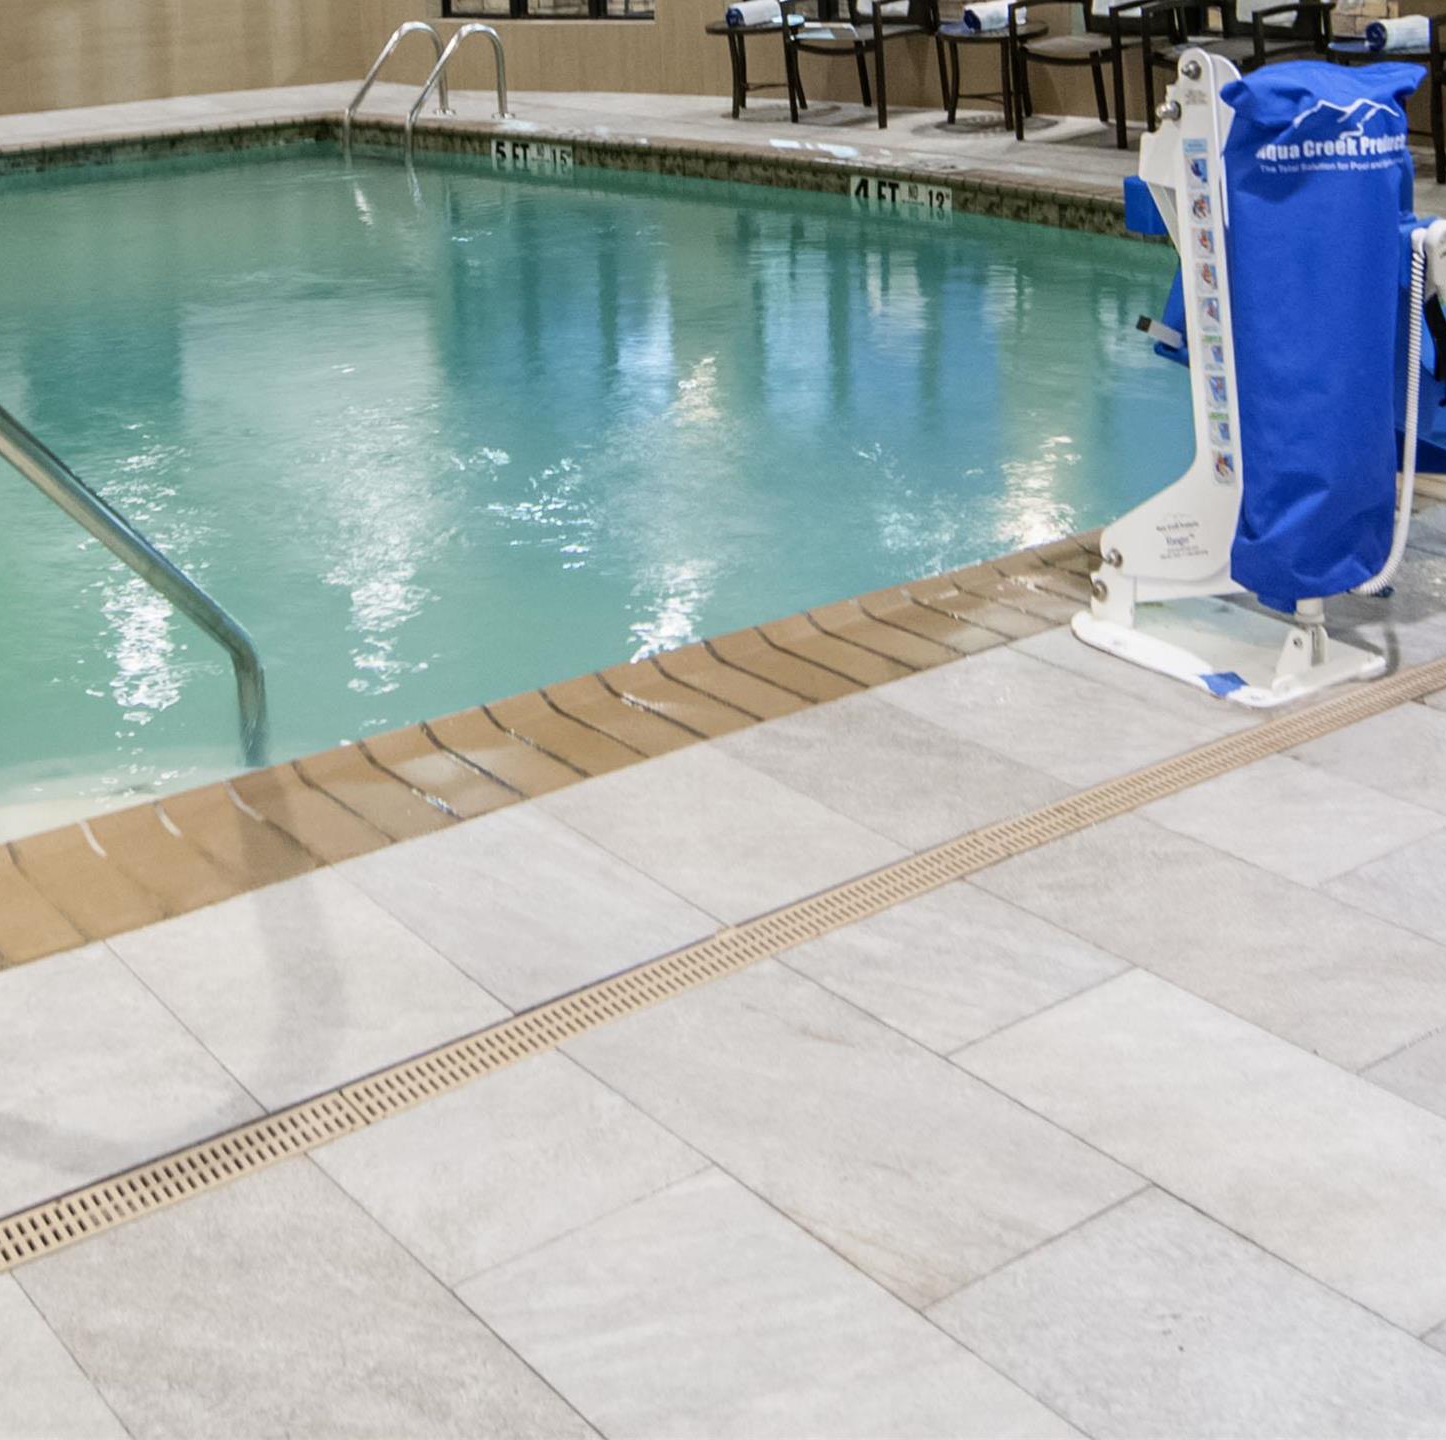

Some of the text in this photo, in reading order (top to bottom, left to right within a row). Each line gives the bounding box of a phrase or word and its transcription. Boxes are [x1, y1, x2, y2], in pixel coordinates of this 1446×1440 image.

[496, 141, 506, 159] 5
[512, 142, 529, 161] FT
[1303, 138, 1358, 158] Creek
[878, 180, 899, 202] FT
